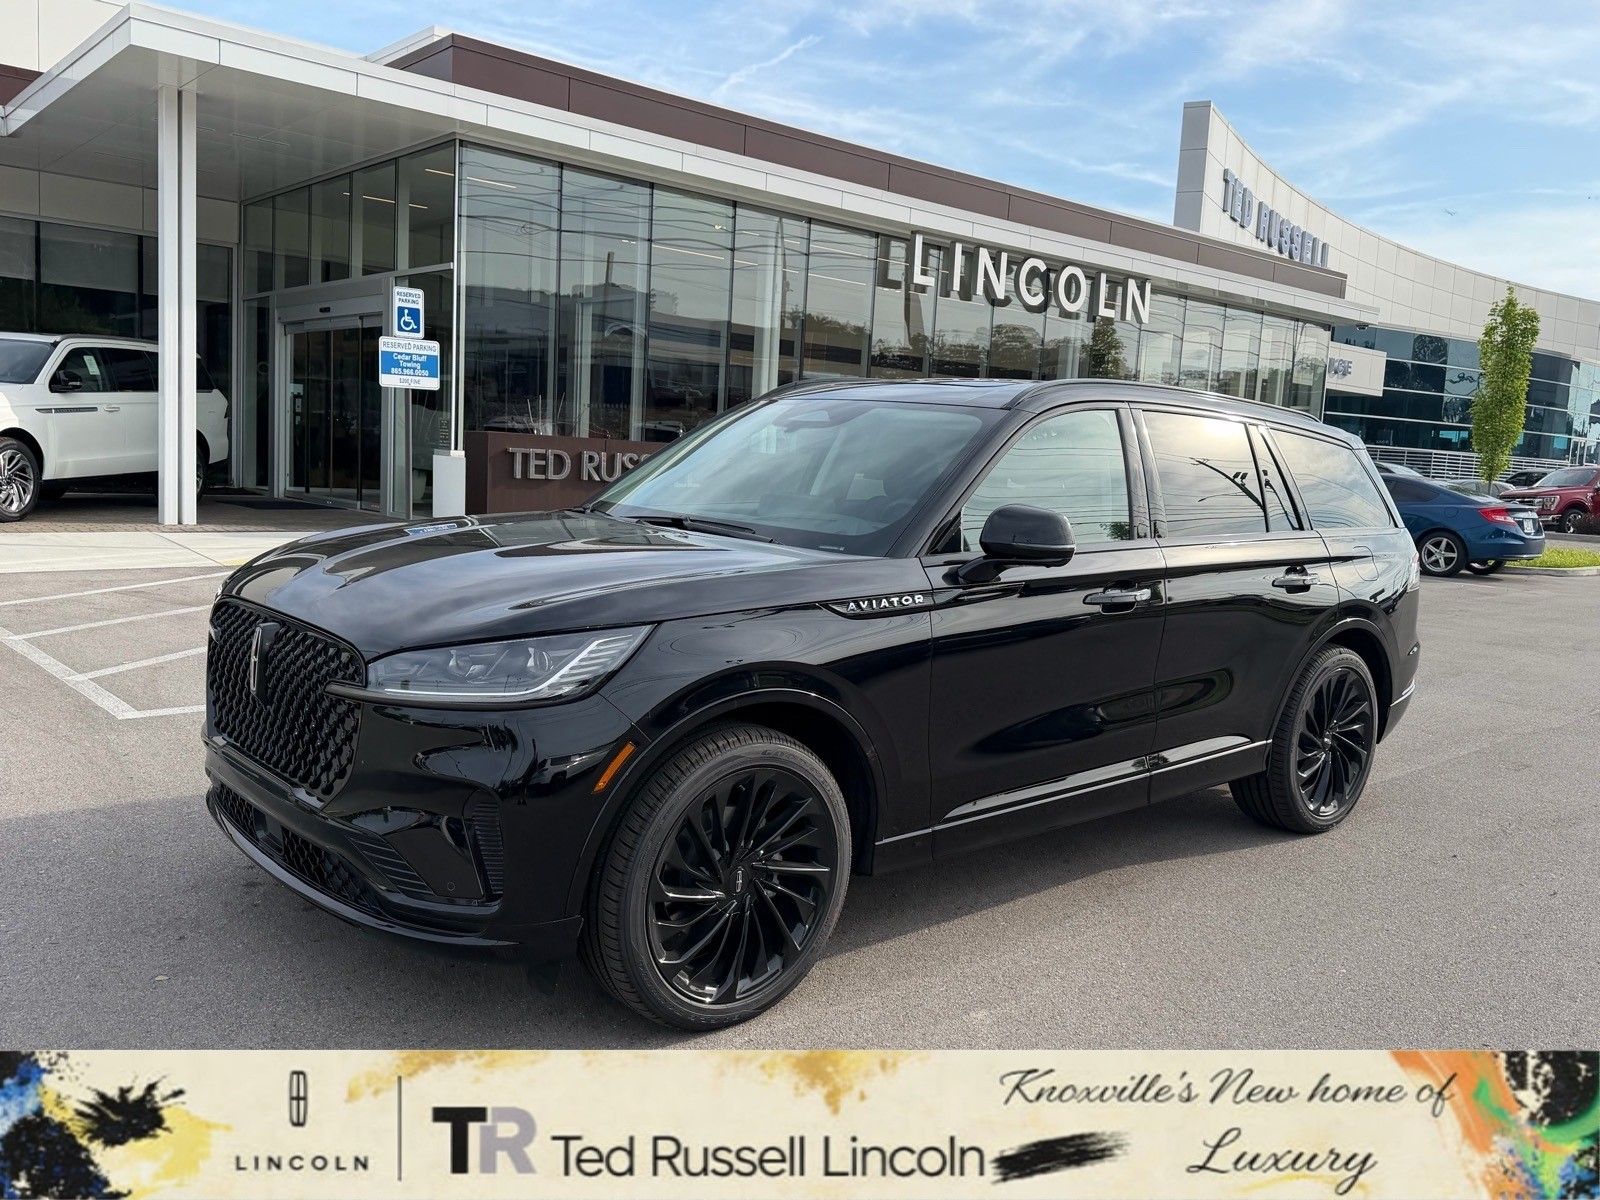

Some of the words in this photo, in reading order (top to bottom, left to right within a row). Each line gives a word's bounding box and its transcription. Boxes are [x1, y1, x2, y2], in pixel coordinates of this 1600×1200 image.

[1223, 168, 1253, 228] TED
[912, 233, 1152, 324] LINCOLN
[398, 297, 420, 305] PARKING
[383, 341, 411, 350] RESERVED
[412, 344, 437, 352] PARKING
[392, 353, 411, 361] Cedar
[399, 361, 421, 370] Towing
[507, 447, 571, 480] TED
[846, 594, 925, 612] AVIATOR
